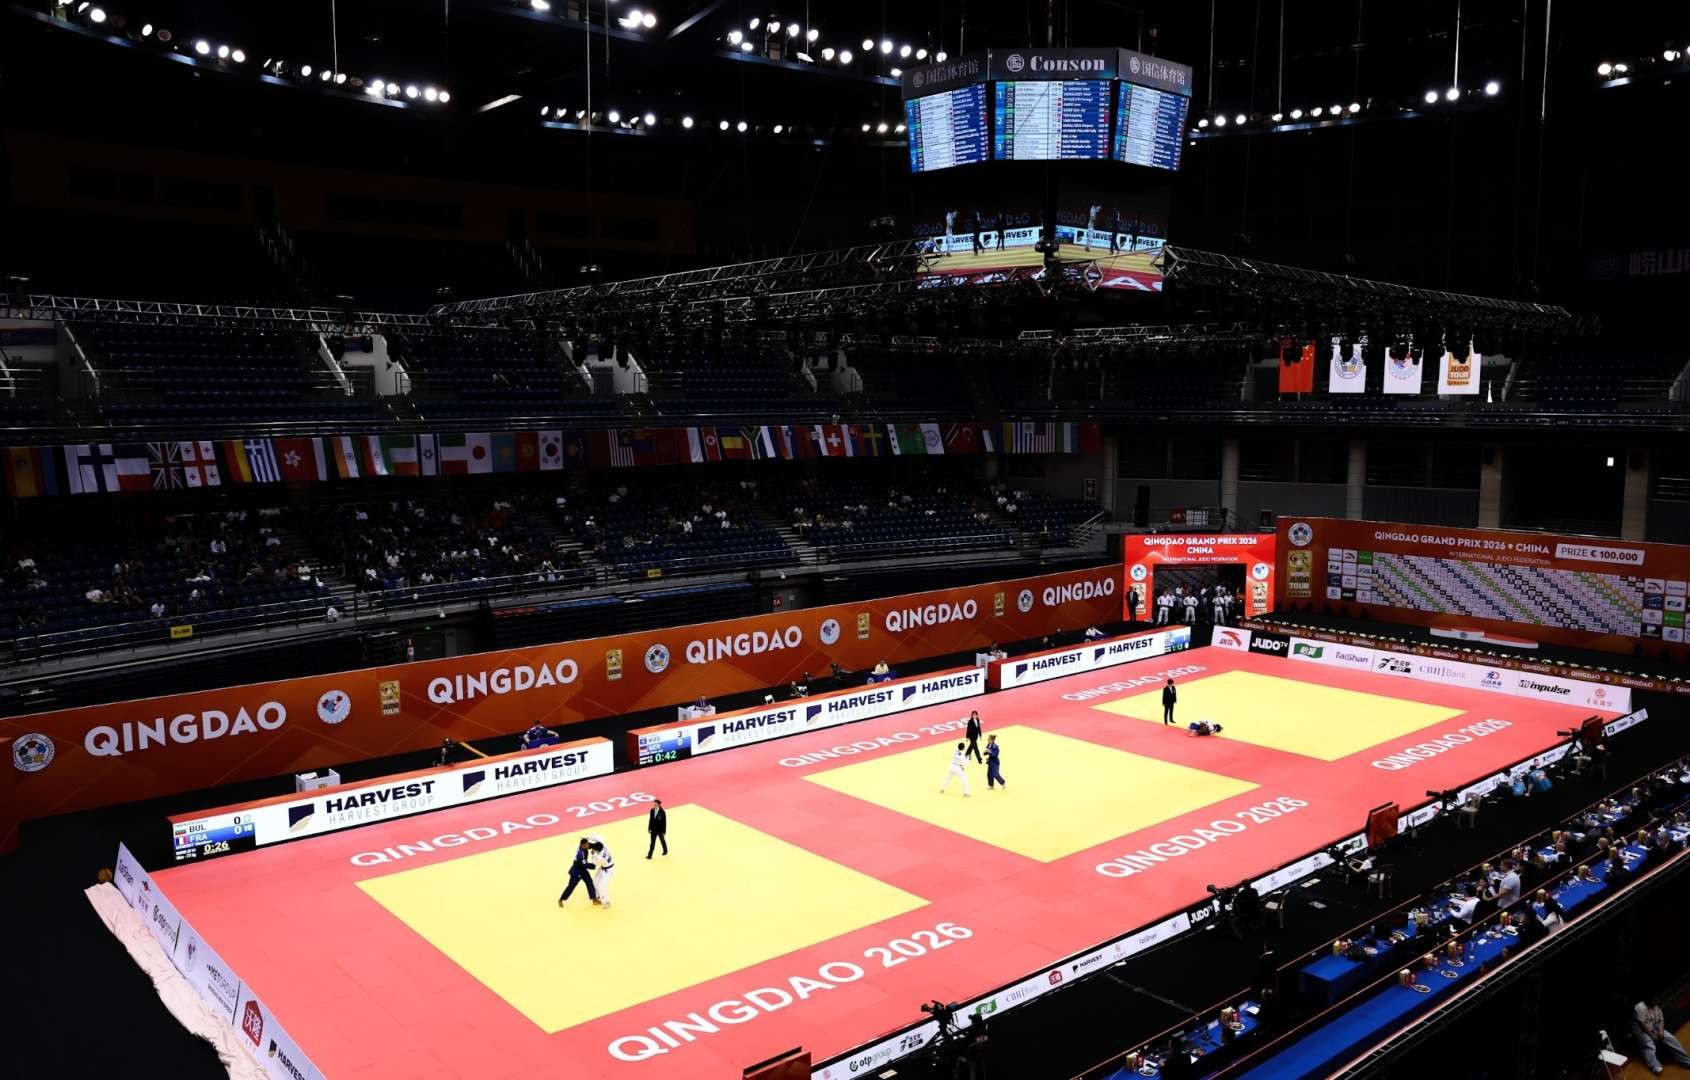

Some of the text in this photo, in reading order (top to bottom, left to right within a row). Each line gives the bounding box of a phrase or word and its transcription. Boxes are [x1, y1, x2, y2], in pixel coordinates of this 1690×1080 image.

[1030, 56, 1105, 72] Conson
[1142, 61, 1185, 86] 国信体育馆
[1374, 531, 1550, 554] QINGDAO GRAND PRIX 2026 CHINA
[1561, 547, 1638, 562] PRIZE € 100,000
[1043, 578, 1114, 608] QINGDAO
[886, 599, 978, 632] QINGDAO
[686, 625, 802, 664] QINGDAO
[1109, 638, 1153, 654] HARVEST
[1032, 652, 1082, 670] HARVEST
[1335, 651, 1368, 664] TaiShan
[427, 658, 578, 705] QINGDAO
[922, 673, 980, 694] HARVEST
[1446, 668, 1466, 680] Bank
[1062, 676, 1158, 701] QINGDAO
[1530, 681, 1571, 696] impulse
[383, 702, 399, 710] JUDO
[383, 708, 400, 716] TOUR
[828, 690, 894, 712] HARVEST
[84, 701, 286, 757] QINGDAO
[722, 710, 796, 734] HARVEST
[655, 750, 676, 762] 0:42
[778, 731, 920, 769] QINGDAO
[1371, 718, 1514, 771] QINGDAO 2026
[495, 751, 589, 780] HARVEST
[498, 765, 587, 791] HARVEST GROUP
[326, 781, 435, 813] HARVEST
[234, 816, 241, 825] 0
[329, 795, 434, 825] HARVEST GROUP
[190, 834, 208, 842] FRA
[350, 792, 656, 866] QINGDAO 2026
[1096, 796, 1309, 878] QINGDAO 2026
[204, 841, 229, 852] 0:26
[1079, 954, 1103, 968] HARVEST
[607, 922, 973, 1062] QINGDAO 2026
